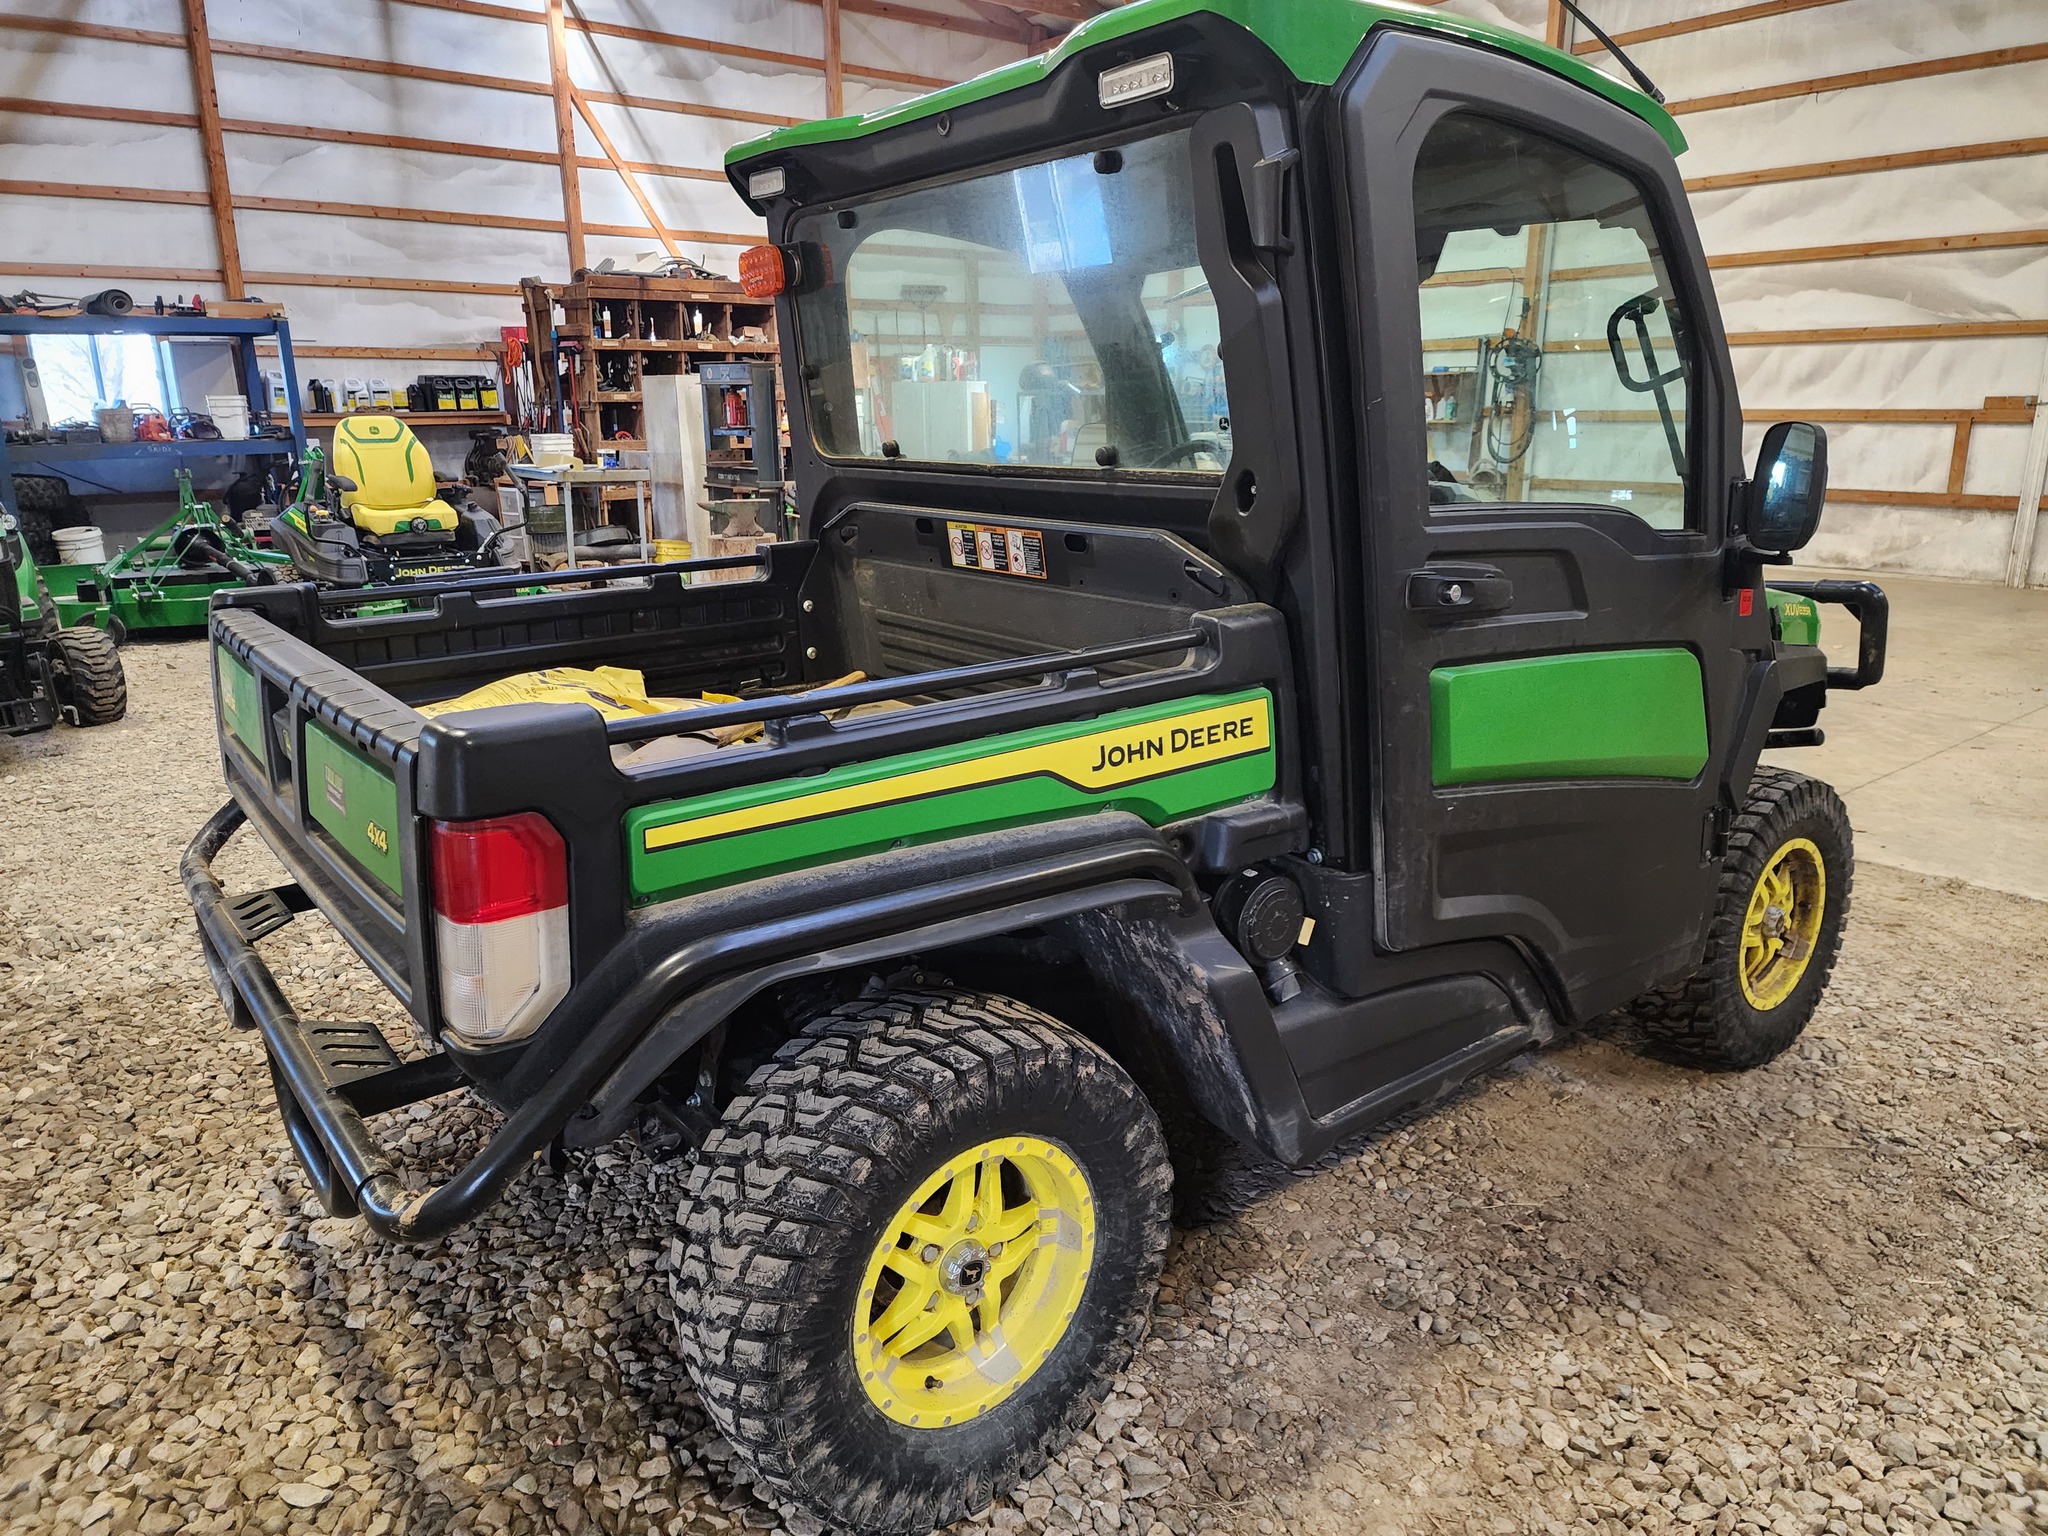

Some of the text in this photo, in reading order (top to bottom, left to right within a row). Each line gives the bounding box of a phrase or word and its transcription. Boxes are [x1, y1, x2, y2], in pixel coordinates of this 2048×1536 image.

[395, 567, 426, 578] JOHN
[1091, 717, 1254, 772] JOHN DEERE
